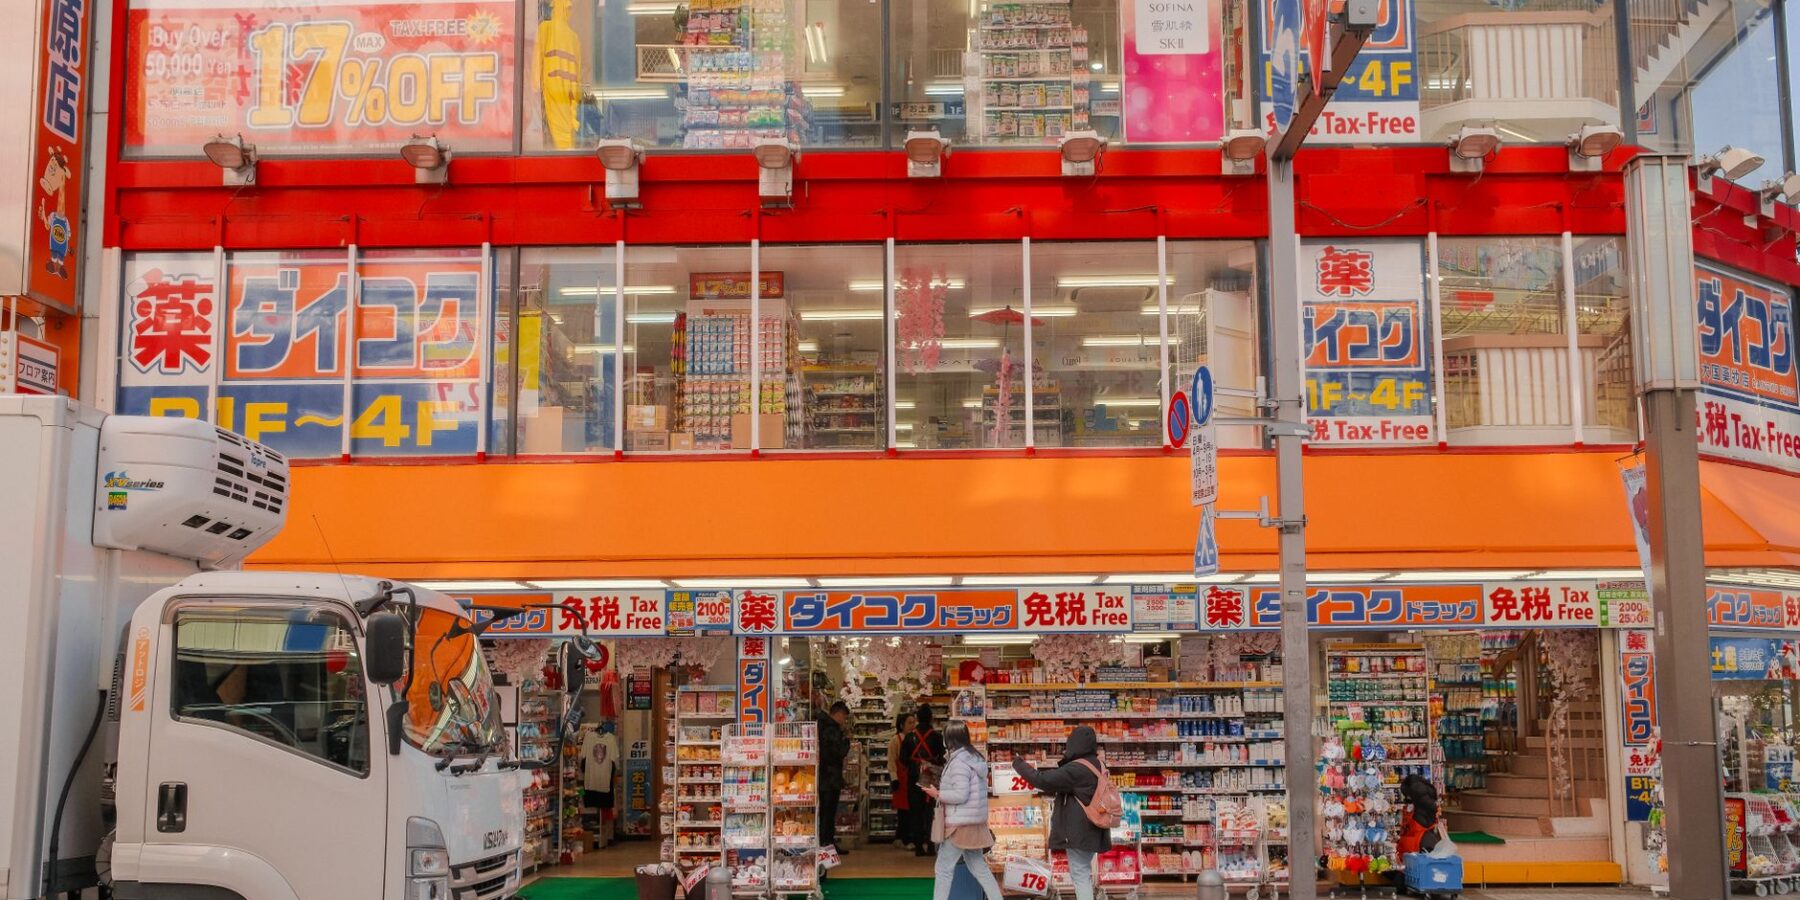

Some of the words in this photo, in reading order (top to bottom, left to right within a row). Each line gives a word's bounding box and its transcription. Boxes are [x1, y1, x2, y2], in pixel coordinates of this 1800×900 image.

[1149, 3, 1193, 12] SOFINA
[151, 26, 183, 51] Buy
[189, 27, 229, 47] Over
[356, 36, 384, 49] MAX
[146, 54, 203, 78] 50,000
[250, 22, 497, 126] 17%OFF
[1323, 112, 1416, 135] Tax-Free
[1318, 246, 1374, 296] 薬
[131, 268, 214, 374] 薬
[234, 270, 480, 374] ダイコク
[1697, 276, 1793, 376] ダイコク
[19, 362, 56, 386] フロア案内
[1335, 420, 1429, 441] Tax-Free
[631, 596, 658, 613] Tax
[1095, 592, 1125, 609] Tax
[1489, 587, 1552, 622] 免税
[1560, 587, 1589, 603] Tax
[558, 595, 621, 630] 免税
[739, 590, 777, 633] 薬
[789, 594, 937, 628] ダイコク
[941, 606, 1011, 627] ドラッグ
[1023, 592, 1088, 627] 免税
[1092, 610, 1128, 626] Free
[1204, 587, 1244, 629] 薬
[1406, 601, 1477, 621] ドラッグ
[1558, 604, 1594, 620] Free
[626, 613, 662, 630] Free
[744, 634, 765, 656] 薬
[1626, 632, 1647, 650] 薬
[1628, 656, 1651, 740] ダイコク
[1020, 873, 1046, 892] 178
